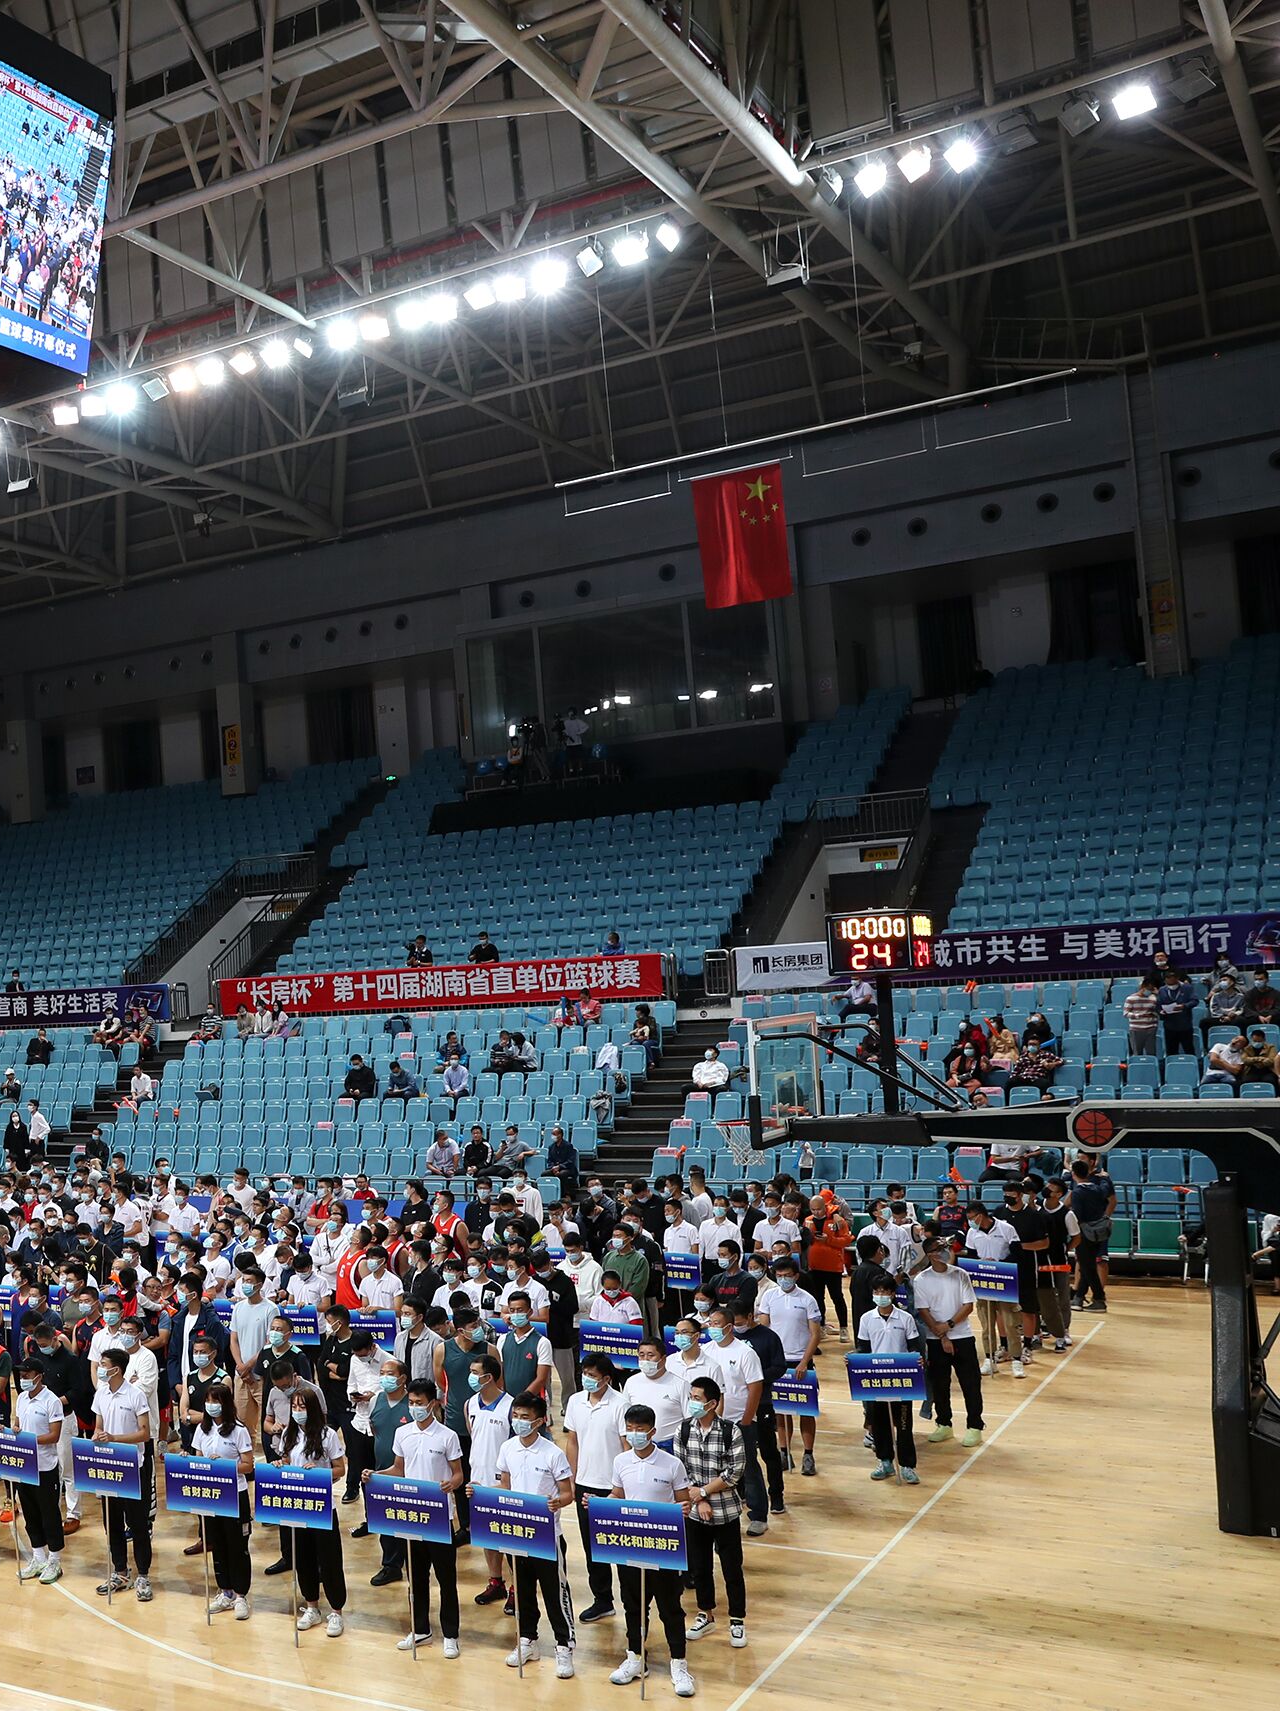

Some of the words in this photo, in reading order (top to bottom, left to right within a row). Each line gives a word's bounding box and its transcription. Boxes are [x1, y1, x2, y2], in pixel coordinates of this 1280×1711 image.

[1059, 922, 1232, 960] 与美好同行
[771, 953, 824, 968] 长房集团
[851, 943, 892, 970] 24
[236, 959, 640, 1006] “长房杯”第十四届湖南省直单位篮球赛
[33, 991, 120, 1015] 美好生活家
[861, 1378, 913, 1388] 省出版集团
[87, 1467, 124, 1482] 省民政厅
[182, 1485, 221, 1499] 省财政厅
[262, 1495, 325, 1512] 省自然资源厅
[385, 1507, 430, 1524] 省商务厅
[489, 1521, 536, 1539] 省住建厅
[595, 1532, 680, 1551] 省文化和旅游厅
